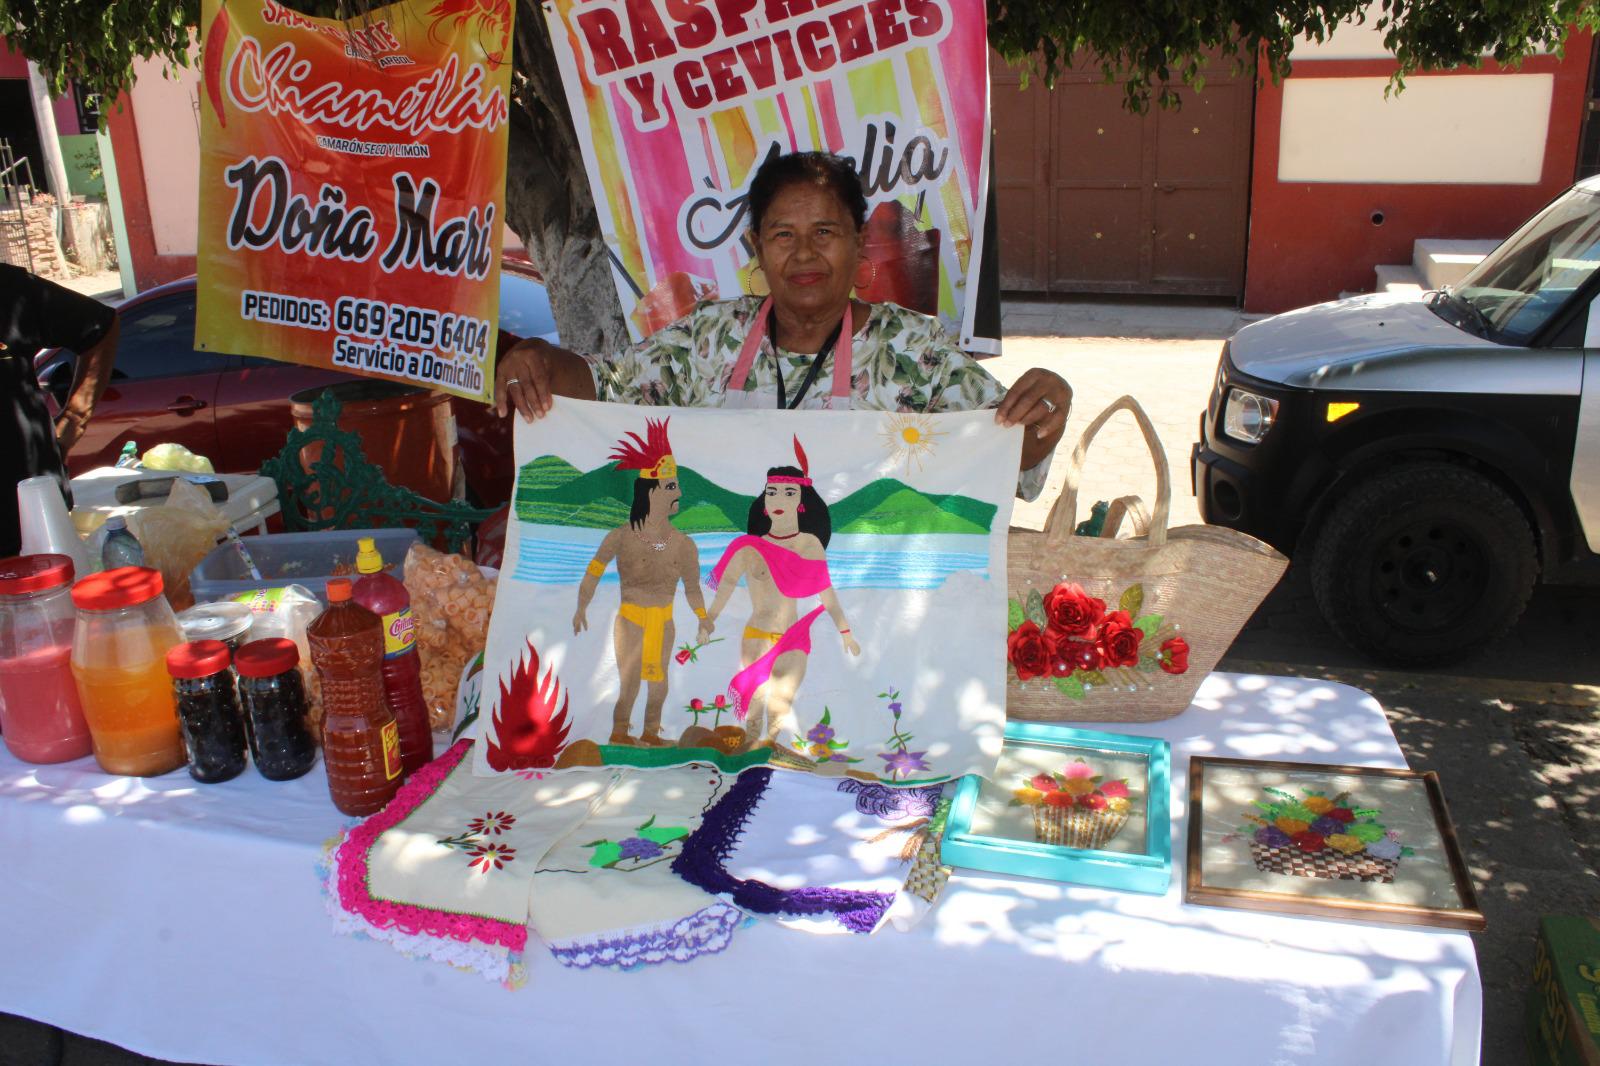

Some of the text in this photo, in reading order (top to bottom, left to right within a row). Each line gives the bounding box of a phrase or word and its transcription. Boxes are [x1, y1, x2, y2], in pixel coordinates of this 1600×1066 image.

[379, 55, 414, 68] ARBOL
[577, 0, 843, 76] RASP
[624, 0, 945, 124] Y CEVICHES
[363, 143, 387, 156] SECO
[387, 144, 395, 157] Y
[395, 142, 430, 158] LIMÓN
[226, 157, 496, 279] Doña Mari
[244, 293, 488, 358] PEDIDOS: 669 205 6404
[335, 339, 482, 391] Servicio a Domicilio
